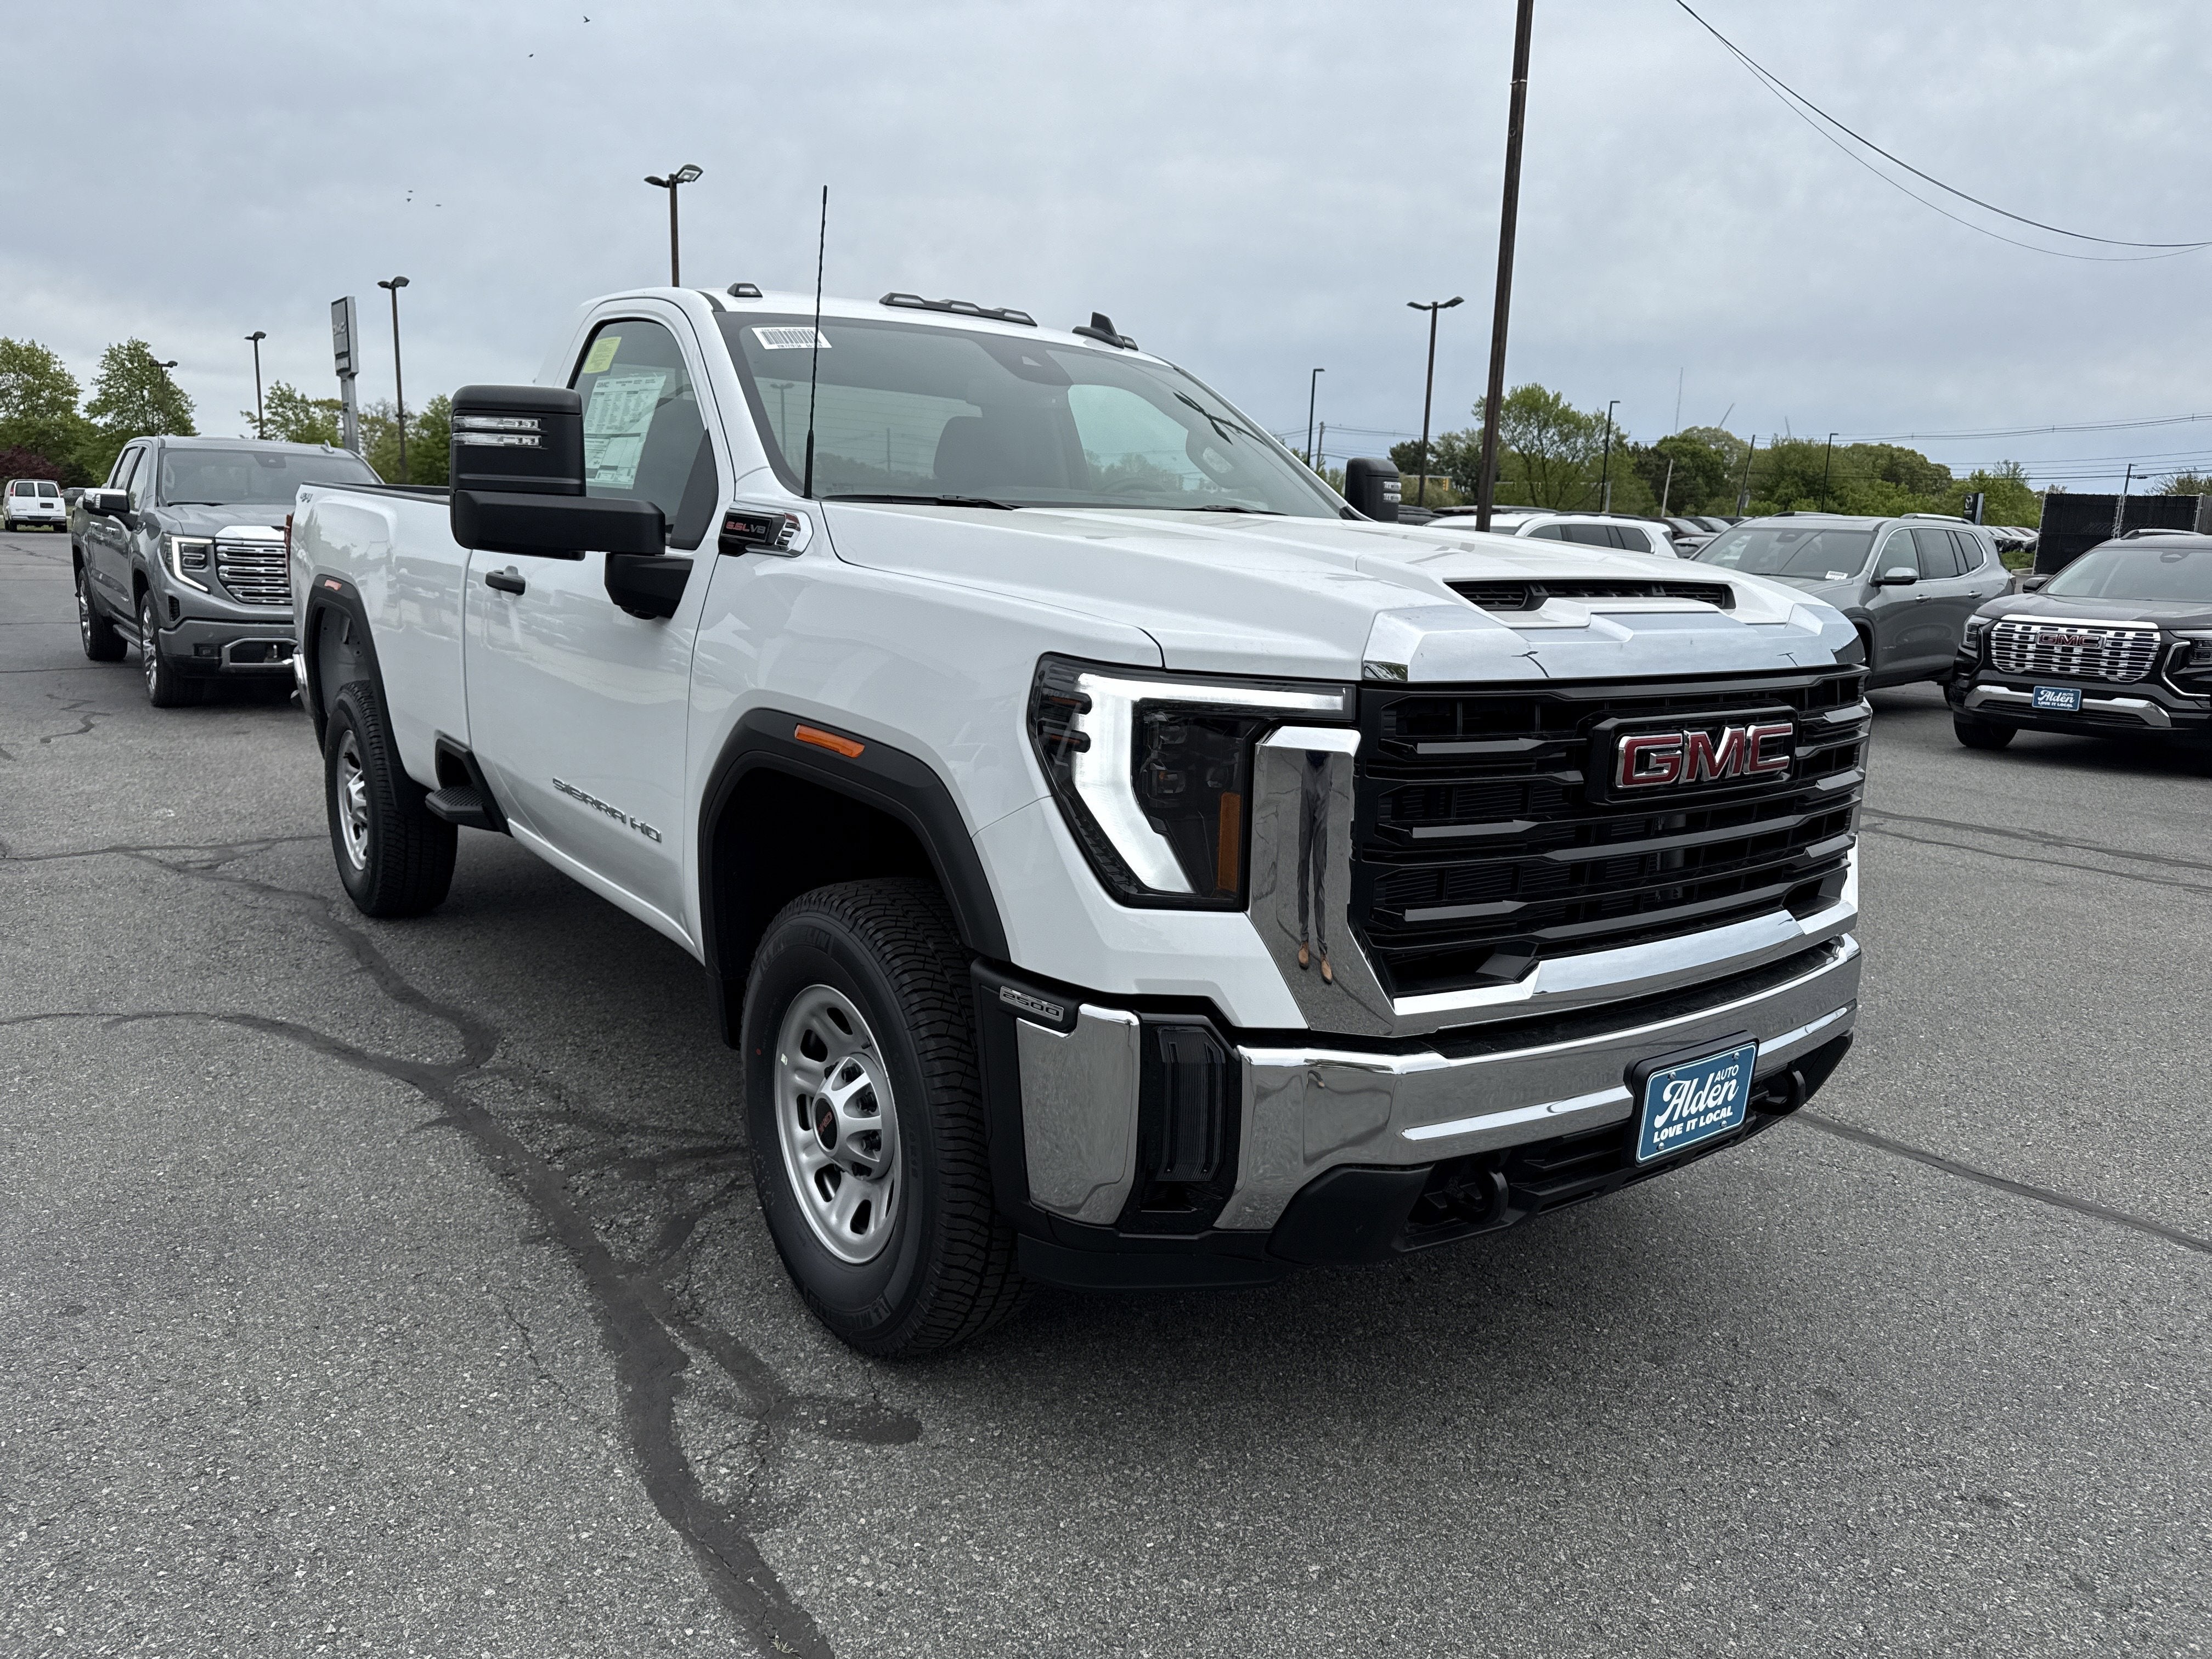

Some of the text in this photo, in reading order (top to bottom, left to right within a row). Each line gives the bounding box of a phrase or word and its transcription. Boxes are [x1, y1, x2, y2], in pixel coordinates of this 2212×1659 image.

[2040, 633, 2100, 647] GMC
[2038, 690, 2075, 703] Alden
[1615, 723, 1793, 789] GMC
[552, 777, 662, 843] SIERRA HD
[1003, 991, 1060, 1017] 2500
[1714, 1064, 1739, 1083] AUTO
[1654, 1073, 1739, 1128] Alden
[1653, 1105, 1733, 1143] LOVE IT LOCAL
